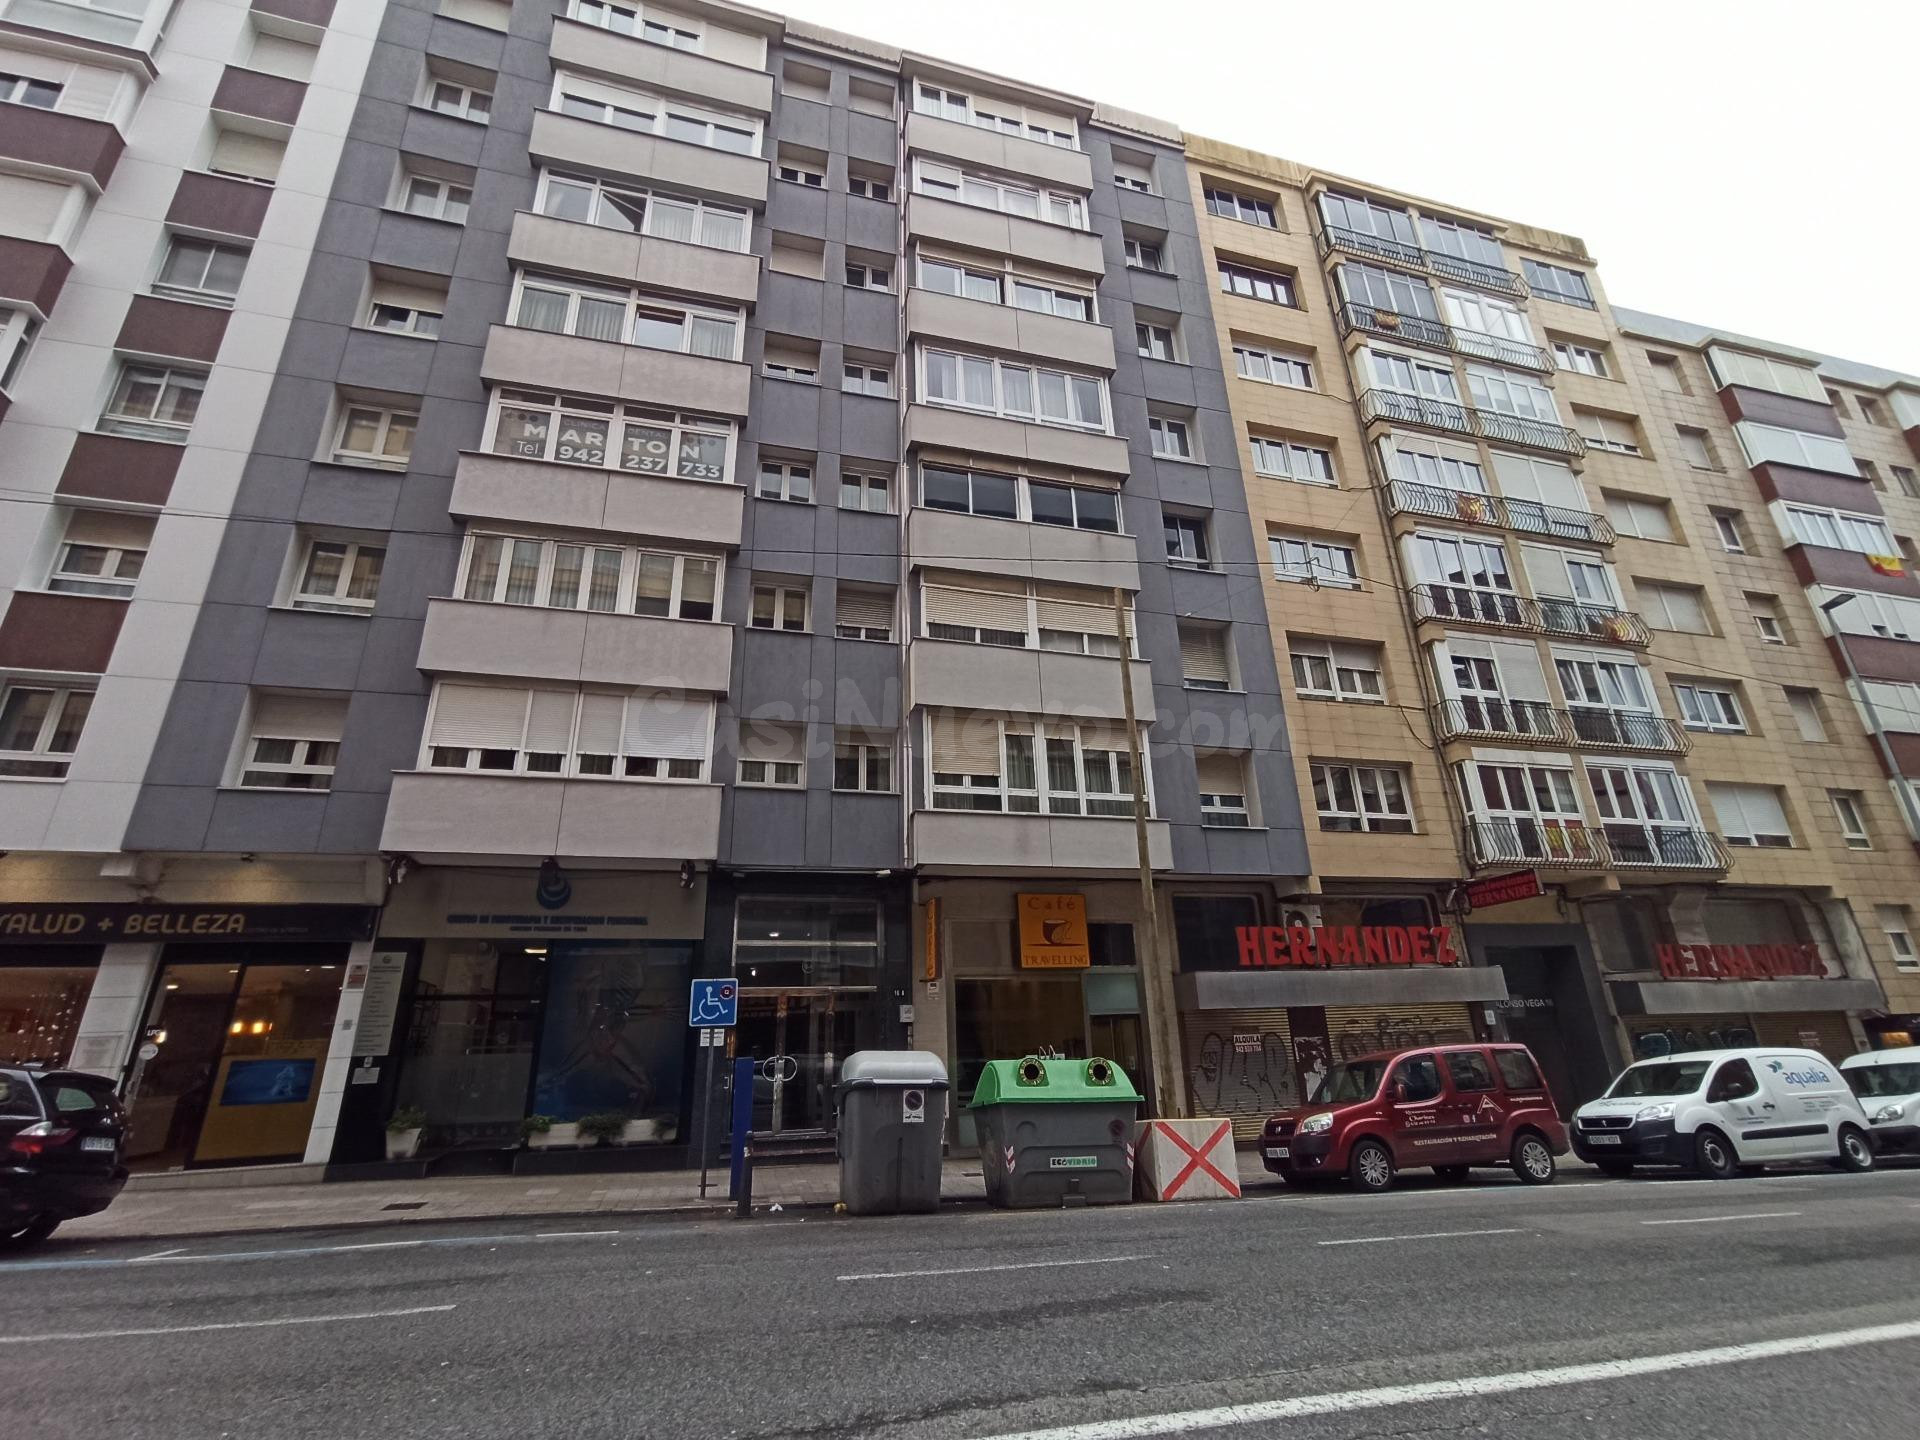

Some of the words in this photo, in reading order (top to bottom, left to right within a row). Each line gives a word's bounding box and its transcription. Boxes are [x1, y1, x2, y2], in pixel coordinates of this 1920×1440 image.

[559, 445, 604, 464] 942
[626, 456, 668, 470] 237
[681, 462, 721, 478] 733
[1026, 895, 1076, 910] Café
[1472, 883, 1537, 906] HERNANDEZ
[124, 914, 246, 934] BELLEZA
[1235, 926, 1458, 966] HERNANDEZ
[1023, 954, 1088, 966] TRAVELLING
[1525, 999, 1545, 1007] VEGA
[1234, 1035, 1260, 1044] ALQUILA
[1782, 1067, 1831, 1088] aqualia
[1052, 1156, 1096, 1167] ECOVIDRIO
